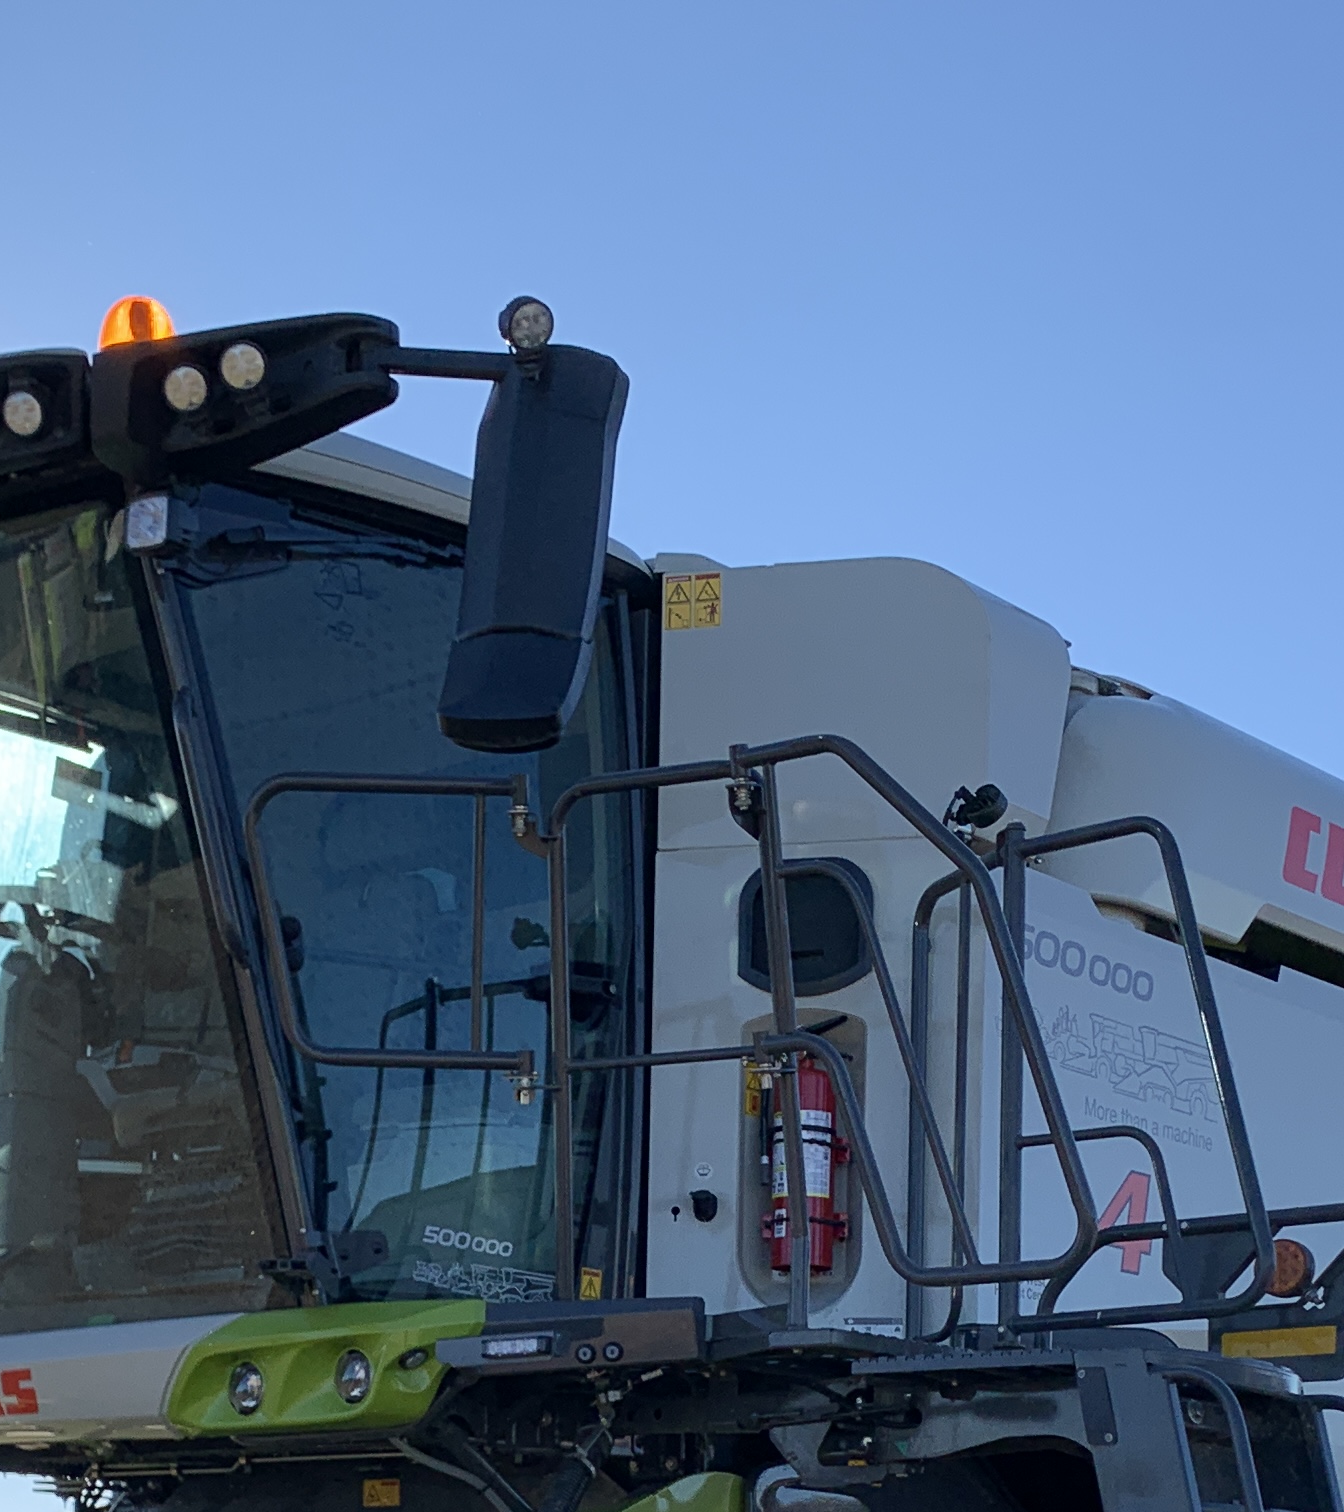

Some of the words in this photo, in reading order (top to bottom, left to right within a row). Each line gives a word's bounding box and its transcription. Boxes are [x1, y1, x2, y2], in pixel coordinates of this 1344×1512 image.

[1084, 1096, 1117, 1123] More
[1121, 1108, 1148, 1130] than
[1152, 1121, 1160, 1136] a
[1162, 1124, 1214, 1152] machine
[1097, 1169, 1152, 1276] 4
